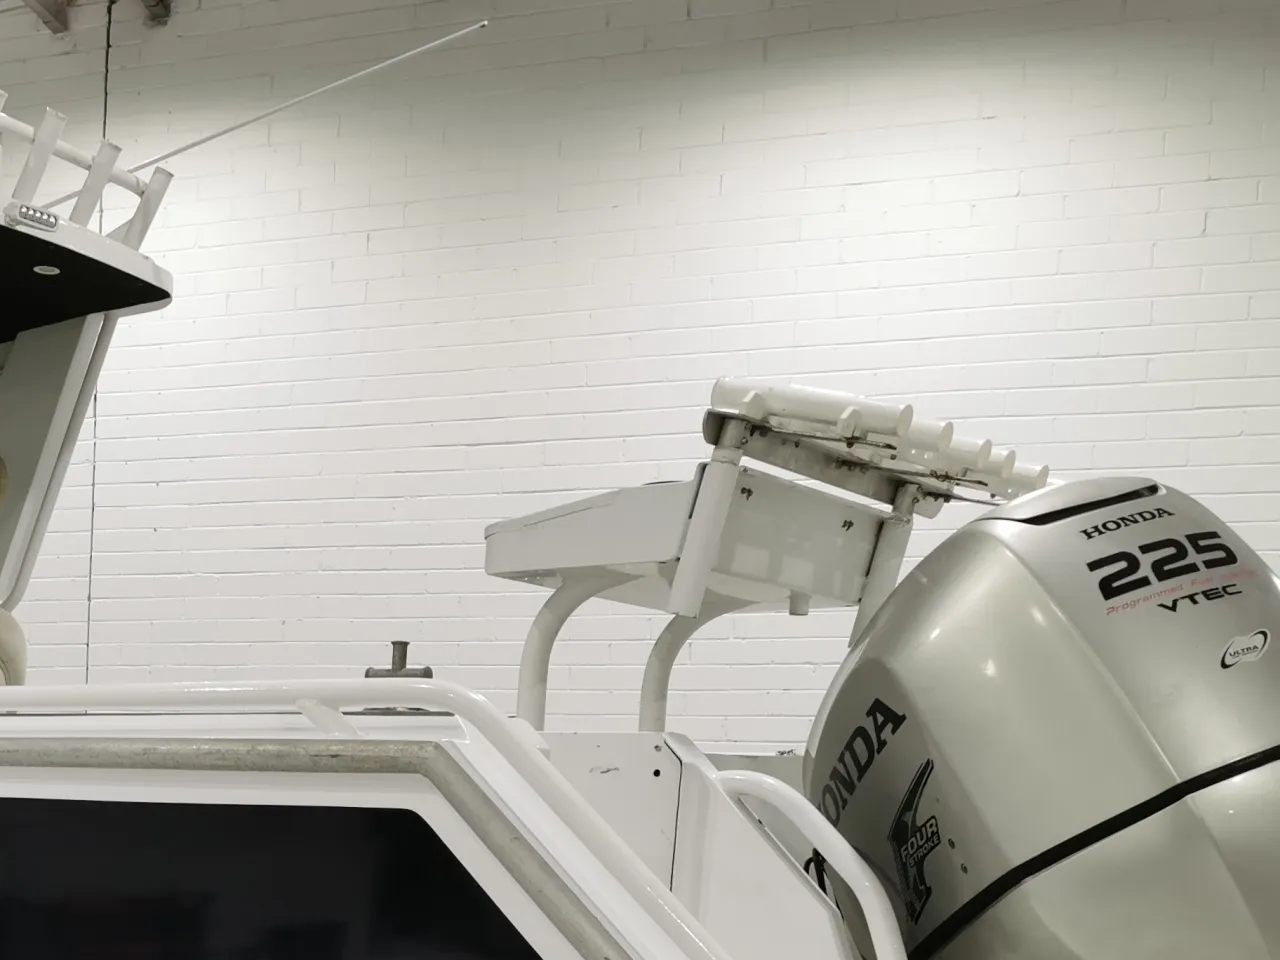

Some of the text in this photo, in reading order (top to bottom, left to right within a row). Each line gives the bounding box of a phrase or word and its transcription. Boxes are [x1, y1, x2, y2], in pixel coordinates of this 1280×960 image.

[1079, 507, 1176, 540] HONDA
[1086, 530, 1239, 602] 225
[1105, 583, 1184, 617] Programmed
[1156, 583, 1243, 613] VTEC
[1228, 644, 1259, 658] ULTRA
[820, 697, 907, 829] ONDA
[900, 817, 939, 862] FOUR
[908, 833, 941, 869] STROKE
